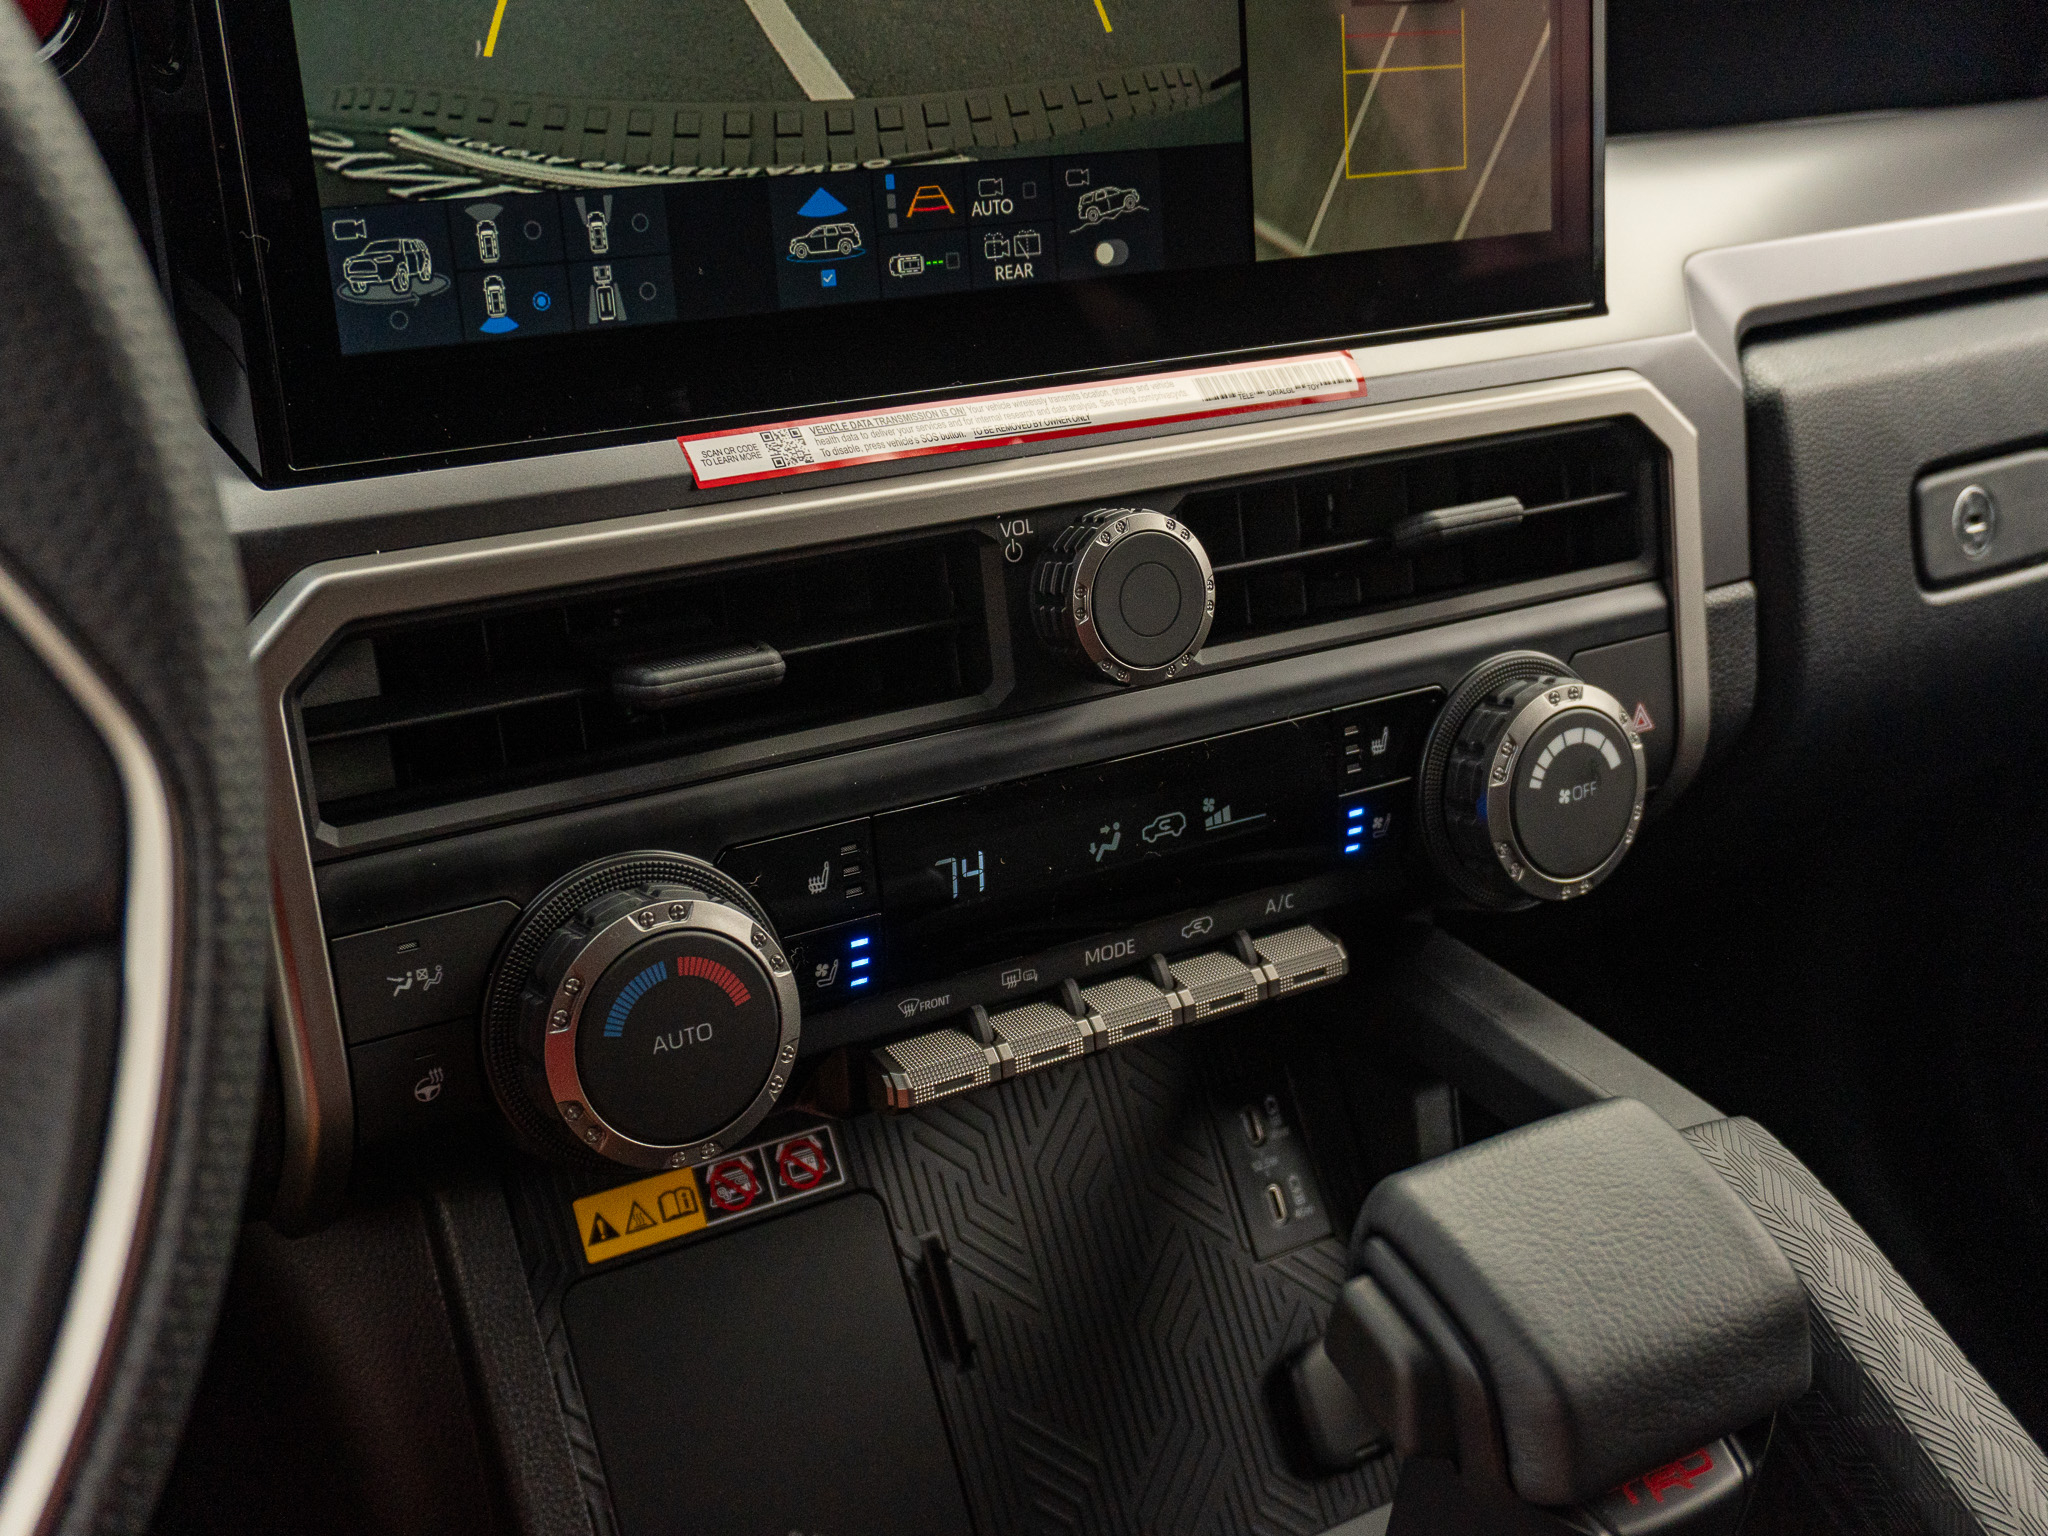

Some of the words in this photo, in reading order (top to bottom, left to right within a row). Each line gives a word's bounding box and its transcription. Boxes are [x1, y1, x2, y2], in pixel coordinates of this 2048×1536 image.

[971, 198, 1014, 217] AUTO
[994, 262, 1034, 281] REAR
[809, 423, 848, 435] VEHICLE
[850, 419, 872, 430] DATA
[873, 410, 938, 427] TRANSMISSION
[939, 409, 948, 417] IS
[950, 406, 966, 416] ON!
[967, 404, 984, 414] Your
[986, 400, 1012, 412] vehicle
[1013, 396, 1047, 409] wirelessly
[1048, 392, 1080, 403] transmits
[1136, 382, 1150, 392] and
[814, 435, 840, 447] health
[841, 432, 858, 442] data
[860, 430, 869, 440] to
[870, 426, 896, 438] deliver
[896, 425, 914, 436] your
[916, 422, 946, 433] services
[948, 418, 962, 428] and
[963, 415, 974, 426] for
[975, 412, 1002, 424] internal
[1003, 408, 1036, 421] research
[1037, 406, 1050, 416] and
[1051, 404, 1068, 414] data
[820, 448, 831, 457] To
[832, 442, 863, 456] disable,
[864, 439, 886, 452] press
[886, 435, 920, 448] vehicle's
[921, 432, 939, 443] SOS
[940, 430, 966, 441] button.
[971, 426, 983, 436] TO
[984, 425, 994, 434] BE
[995, 421, 1032, 433] REMOVED
[1044, 416, 1072, 426] OWNER
[1072, 413, 1091, 424] ONLY
[700, 458, 712, 467] TO
[714, 454, 739, 466] LEARN
[740, 451, 762, 462] MORE
[701, 449, 723, 458] SCAN
[724, 447, 736, 455] QR
[736, 444, 758, 453] CODE
[1000, 518, 1034, 537] VOL
[1572, 781, 1598, 801] OFF
[935, 850, 985, 899] 74
[1265, 893, 1296, 915] A/C
[1084, 937, 1137, 966] MODE
[919, 994, 951, 1012] FRONT
[652, 1022, 714, 1056] AUTO
